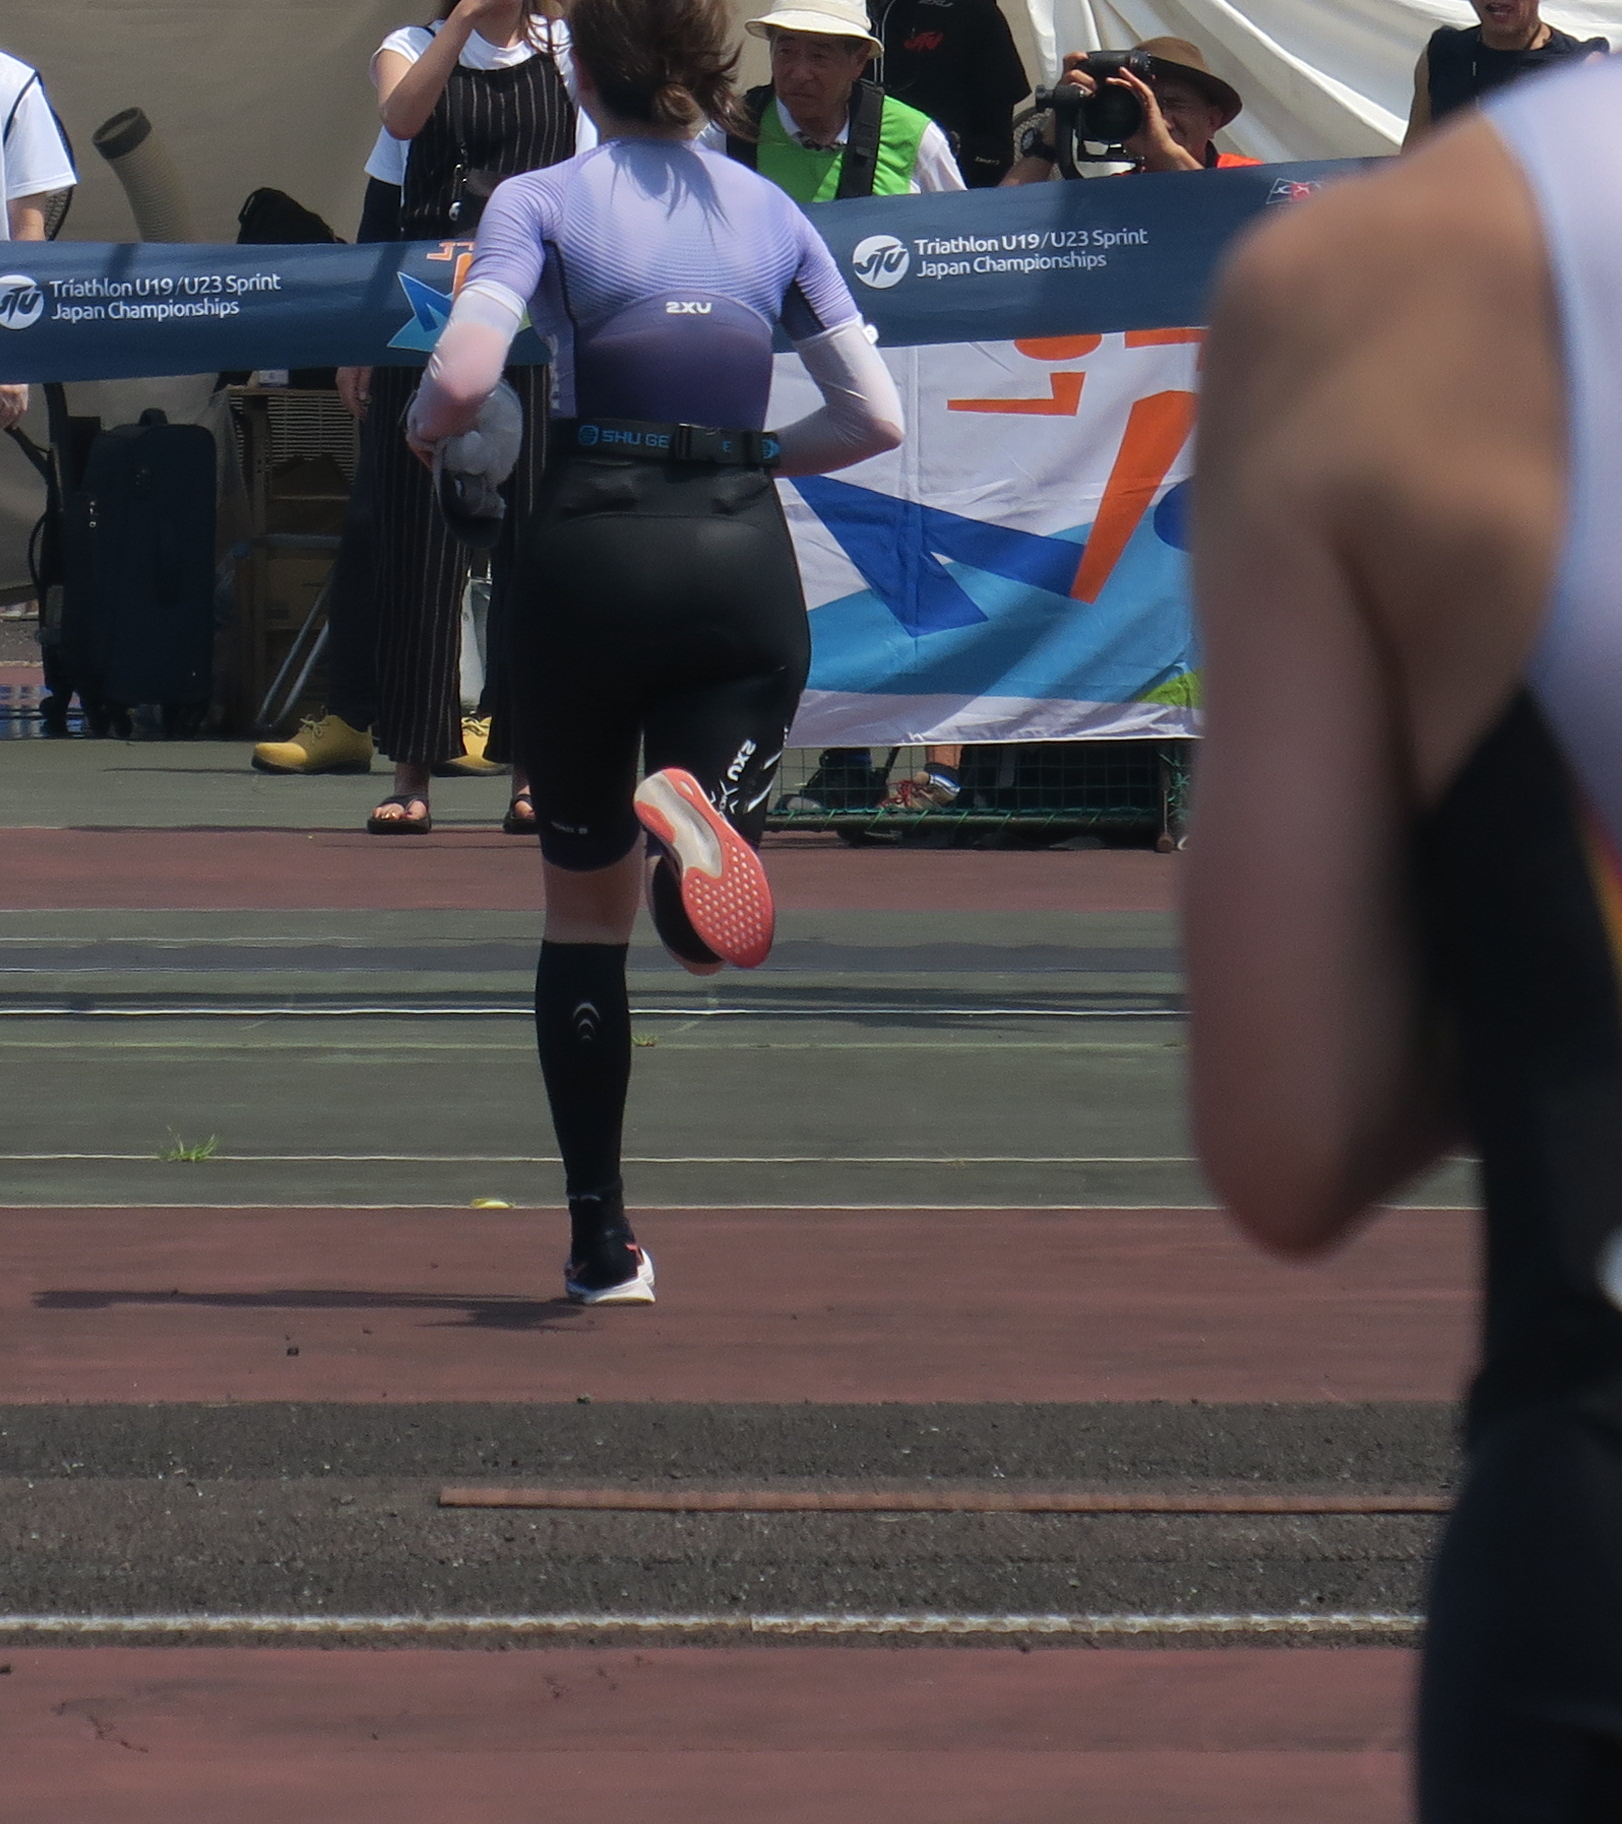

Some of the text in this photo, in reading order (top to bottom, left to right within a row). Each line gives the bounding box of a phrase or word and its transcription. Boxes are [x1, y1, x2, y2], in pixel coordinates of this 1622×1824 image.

[914, 235, 999, 257] Triathlon
[1092, 226, 1149, 247] Sprint
[916, 251, 1108, 281] Japan Championships
[49, 278, 131, 298] Triathlon
[226, 273, 282, 295] Sprint
[51, 297, 240, 324] Japan Championships
[665, 301, 713, 314] 2XU
[727, 738, 757, 782] 2XU
